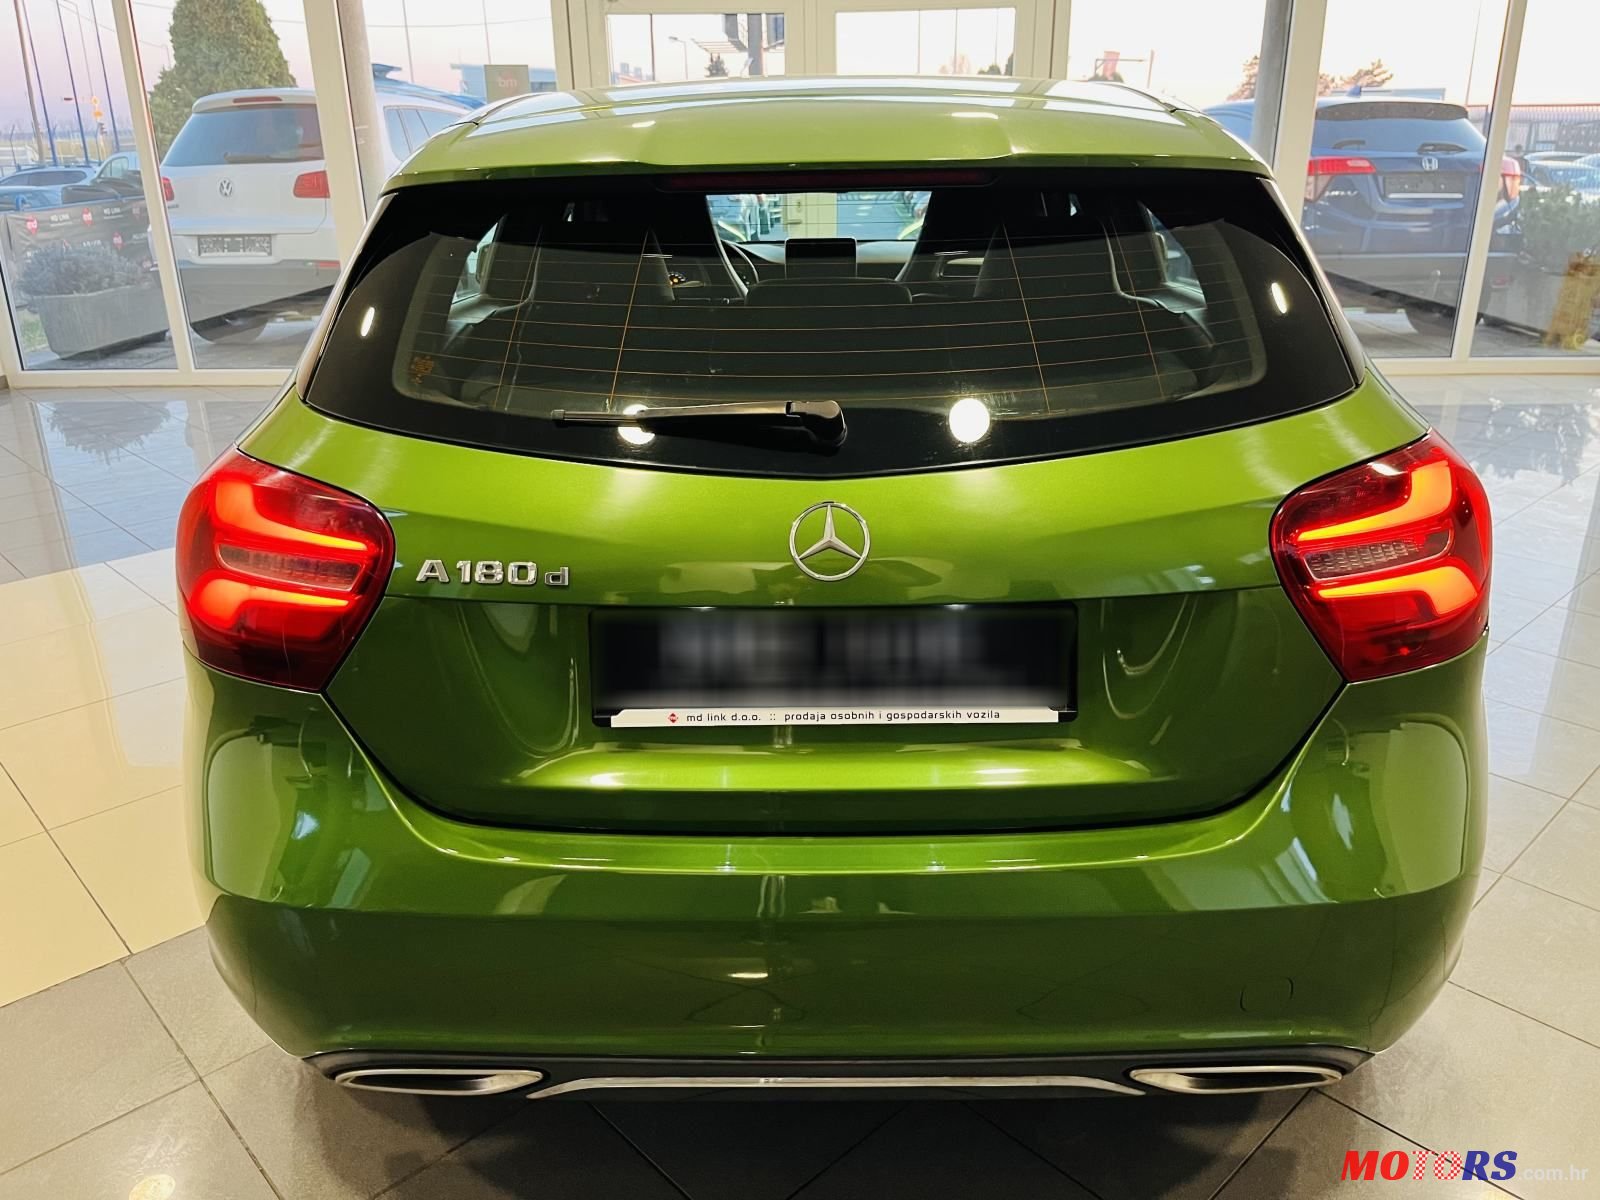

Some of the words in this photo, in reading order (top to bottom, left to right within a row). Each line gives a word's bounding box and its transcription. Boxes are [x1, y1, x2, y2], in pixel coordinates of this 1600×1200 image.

[686, 713, 703, 722] md
[707, 713, 726, 722] link
[731, 712, 761, 722] d.o.o.
[784, 711, 826, 723] prodaja
[830, 711, 874, 721] osobnih
[886, 710, 962, 722] gospodarskih
[966, 710, 1000, 719] vozila
